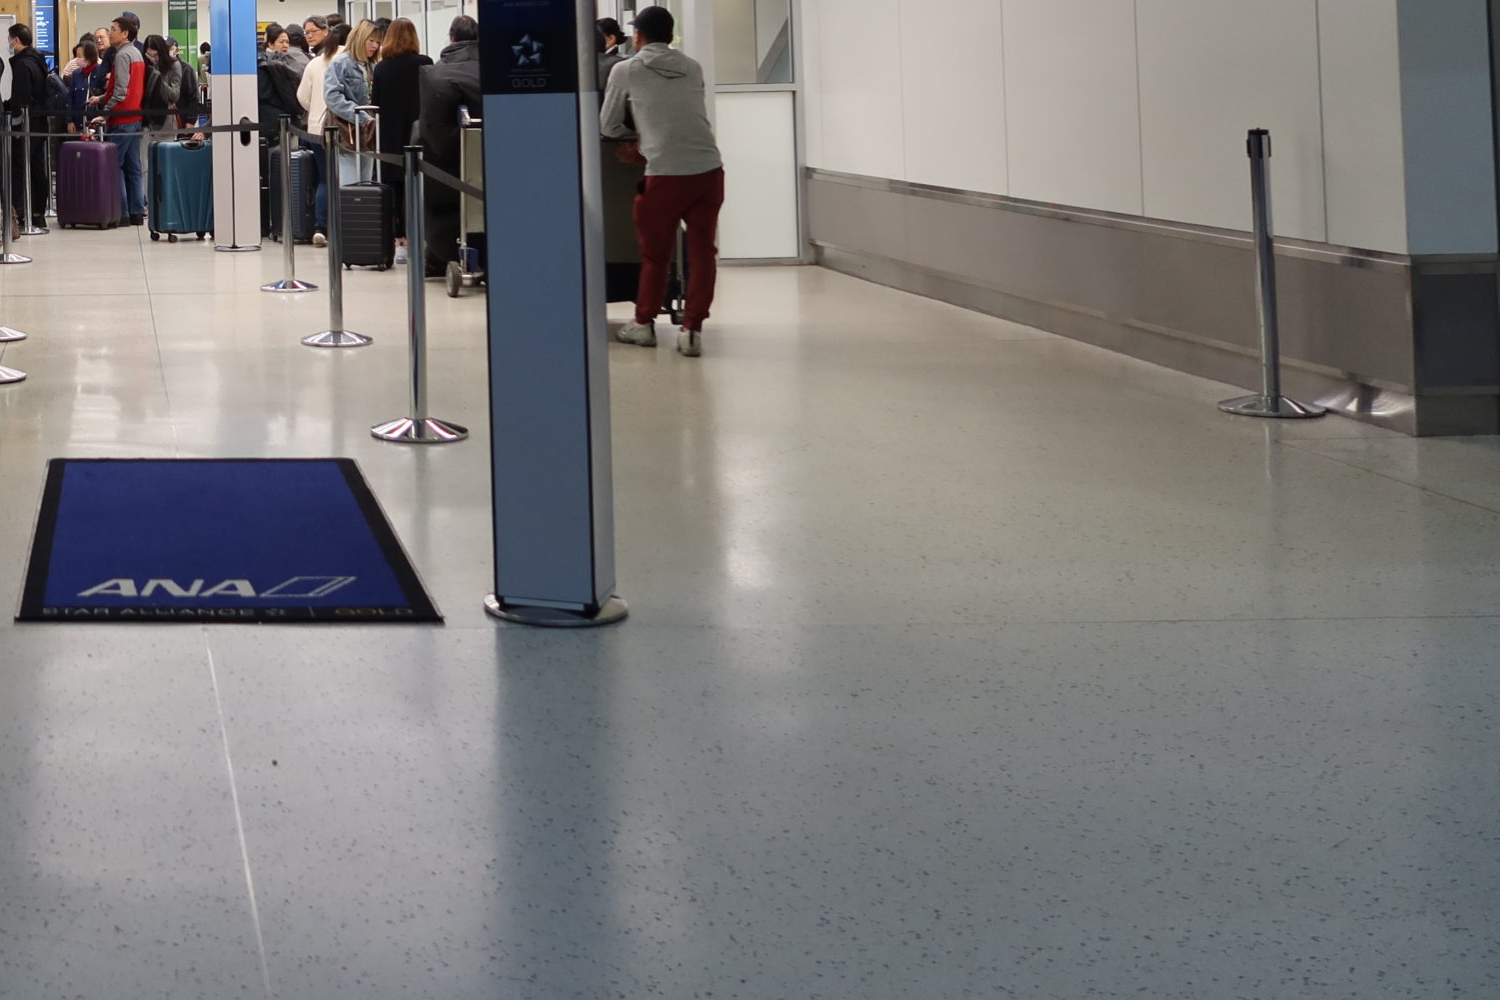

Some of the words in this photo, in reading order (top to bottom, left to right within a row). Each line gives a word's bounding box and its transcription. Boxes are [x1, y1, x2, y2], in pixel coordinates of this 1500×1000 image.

[512, 77, 547, 89] GOLD
[76, 578, 257, 598] ANA
[42, 607, 109, 615] STAR
[120, 607, 255, 616] ALLIANCE
[334, 607, 414, 615] GOLD
